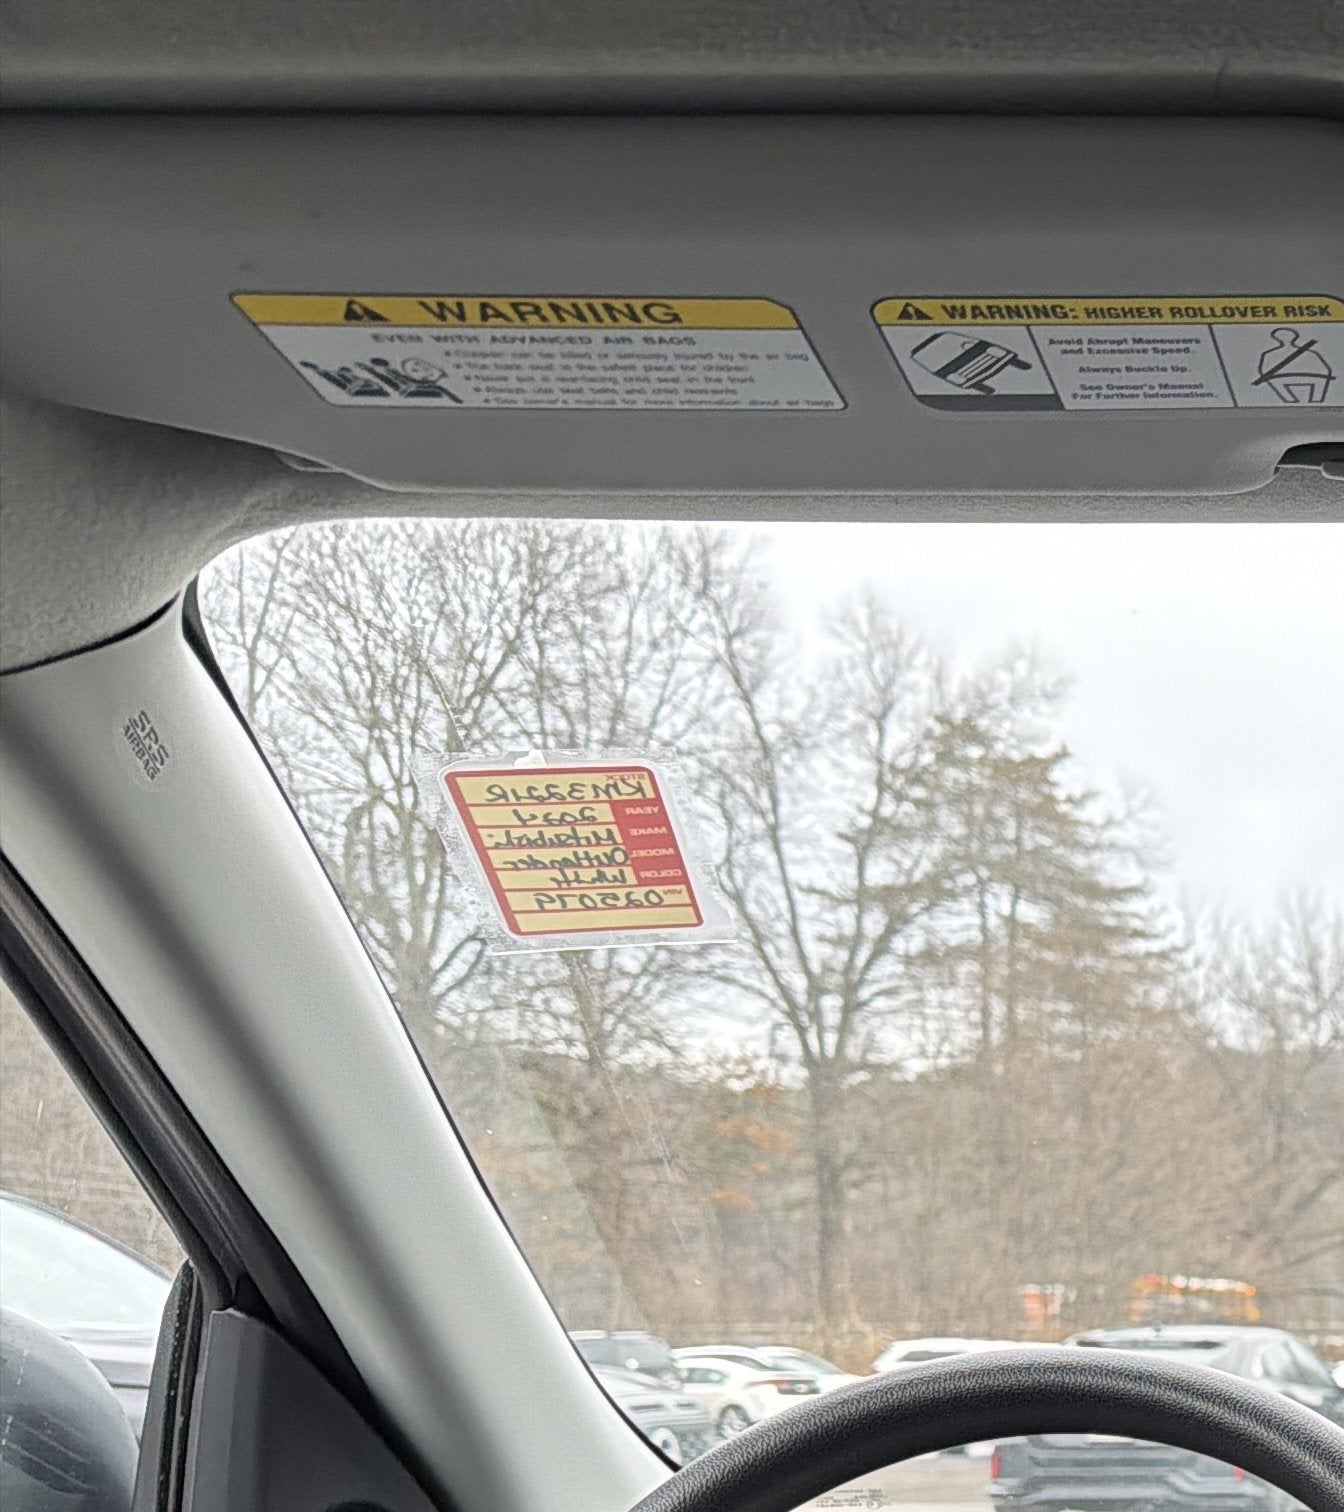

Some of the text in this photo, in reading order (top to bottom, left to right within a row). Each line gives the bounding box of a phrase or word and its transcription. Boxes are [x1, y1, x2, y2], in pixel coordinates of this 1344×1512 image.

[418, 300, 684, 324] WARNING
[940, 304, 1332, 320] WARNING: HIGHER ROLLOVER RISK
[1048, 337, 1201, 347] Avoid Abrupt Maneuvers
[133, 709, 170, 768] SRS
[122, 724, 161, 781] AIRBAG
